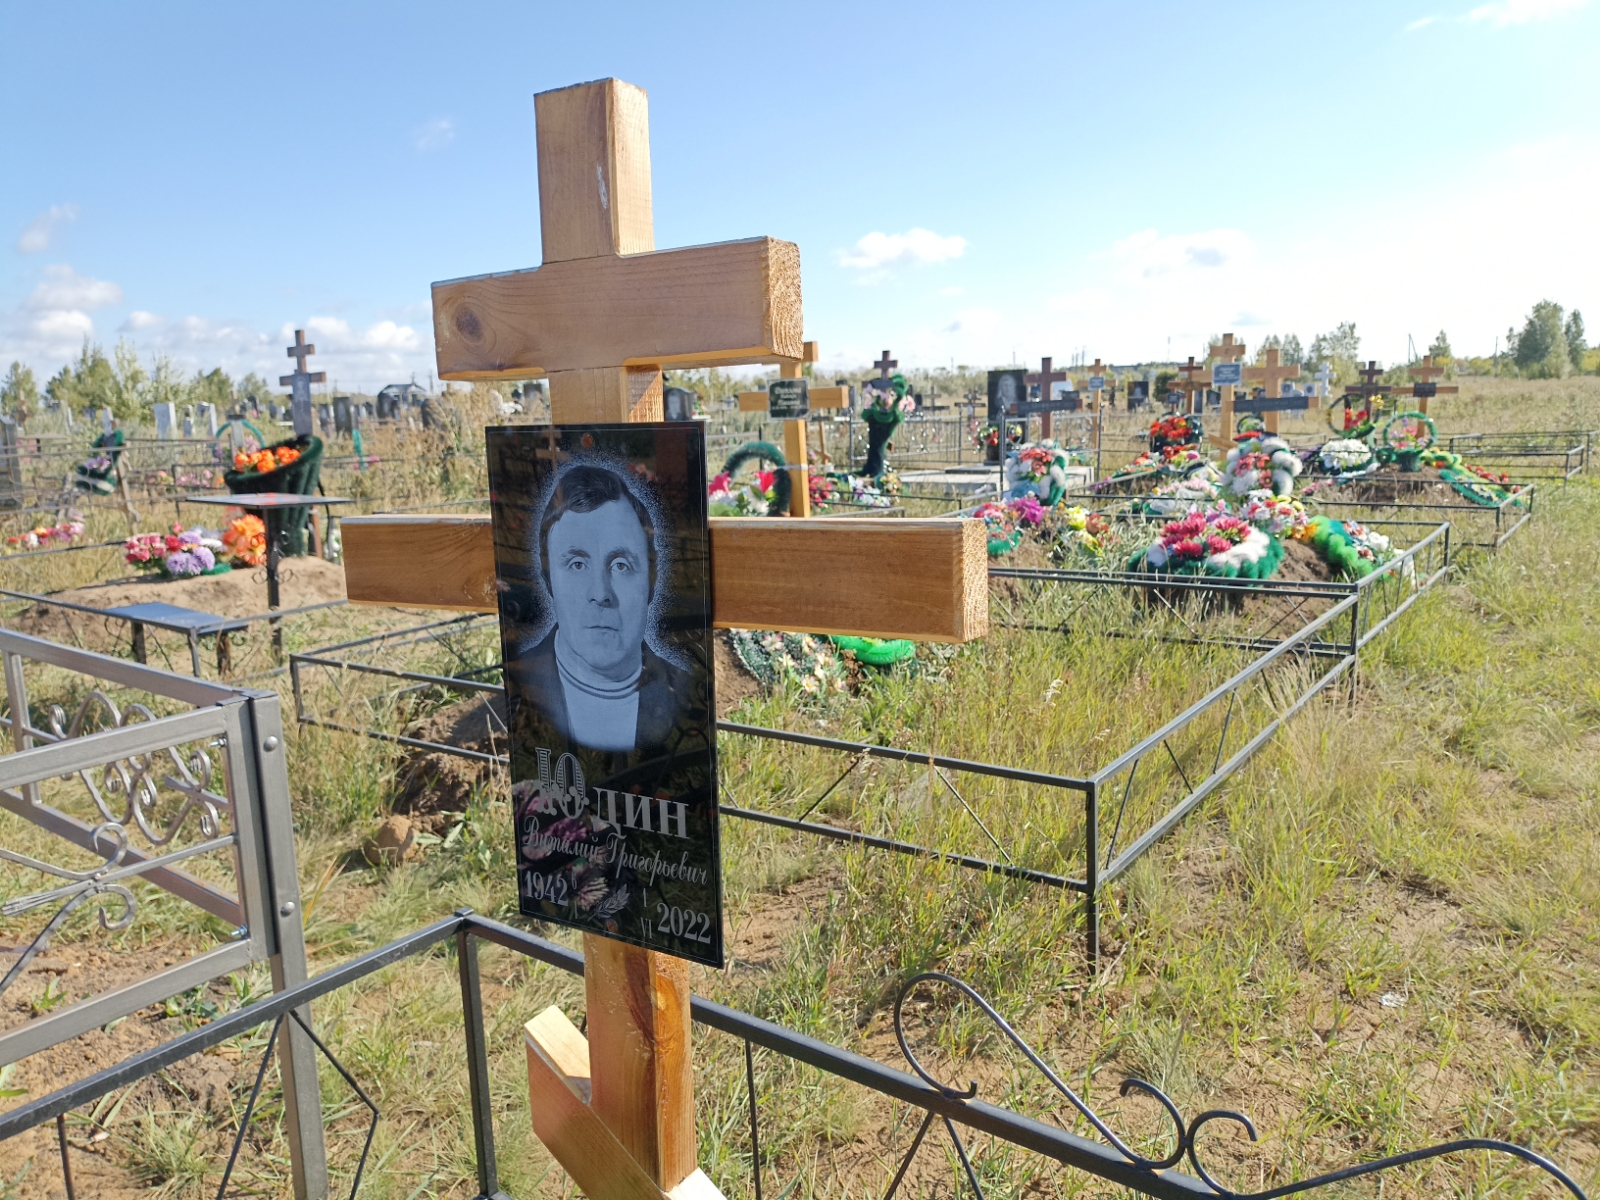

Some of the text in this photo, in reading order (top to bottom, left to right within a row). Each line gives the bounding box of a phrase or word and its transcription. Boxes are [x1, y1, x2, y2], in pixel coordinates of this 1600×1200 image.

[523, 816, 708, 886] Виталий Григорьевич
[524, 871, 568, 906] 1942
[657, 902, 711, 944] 2022
